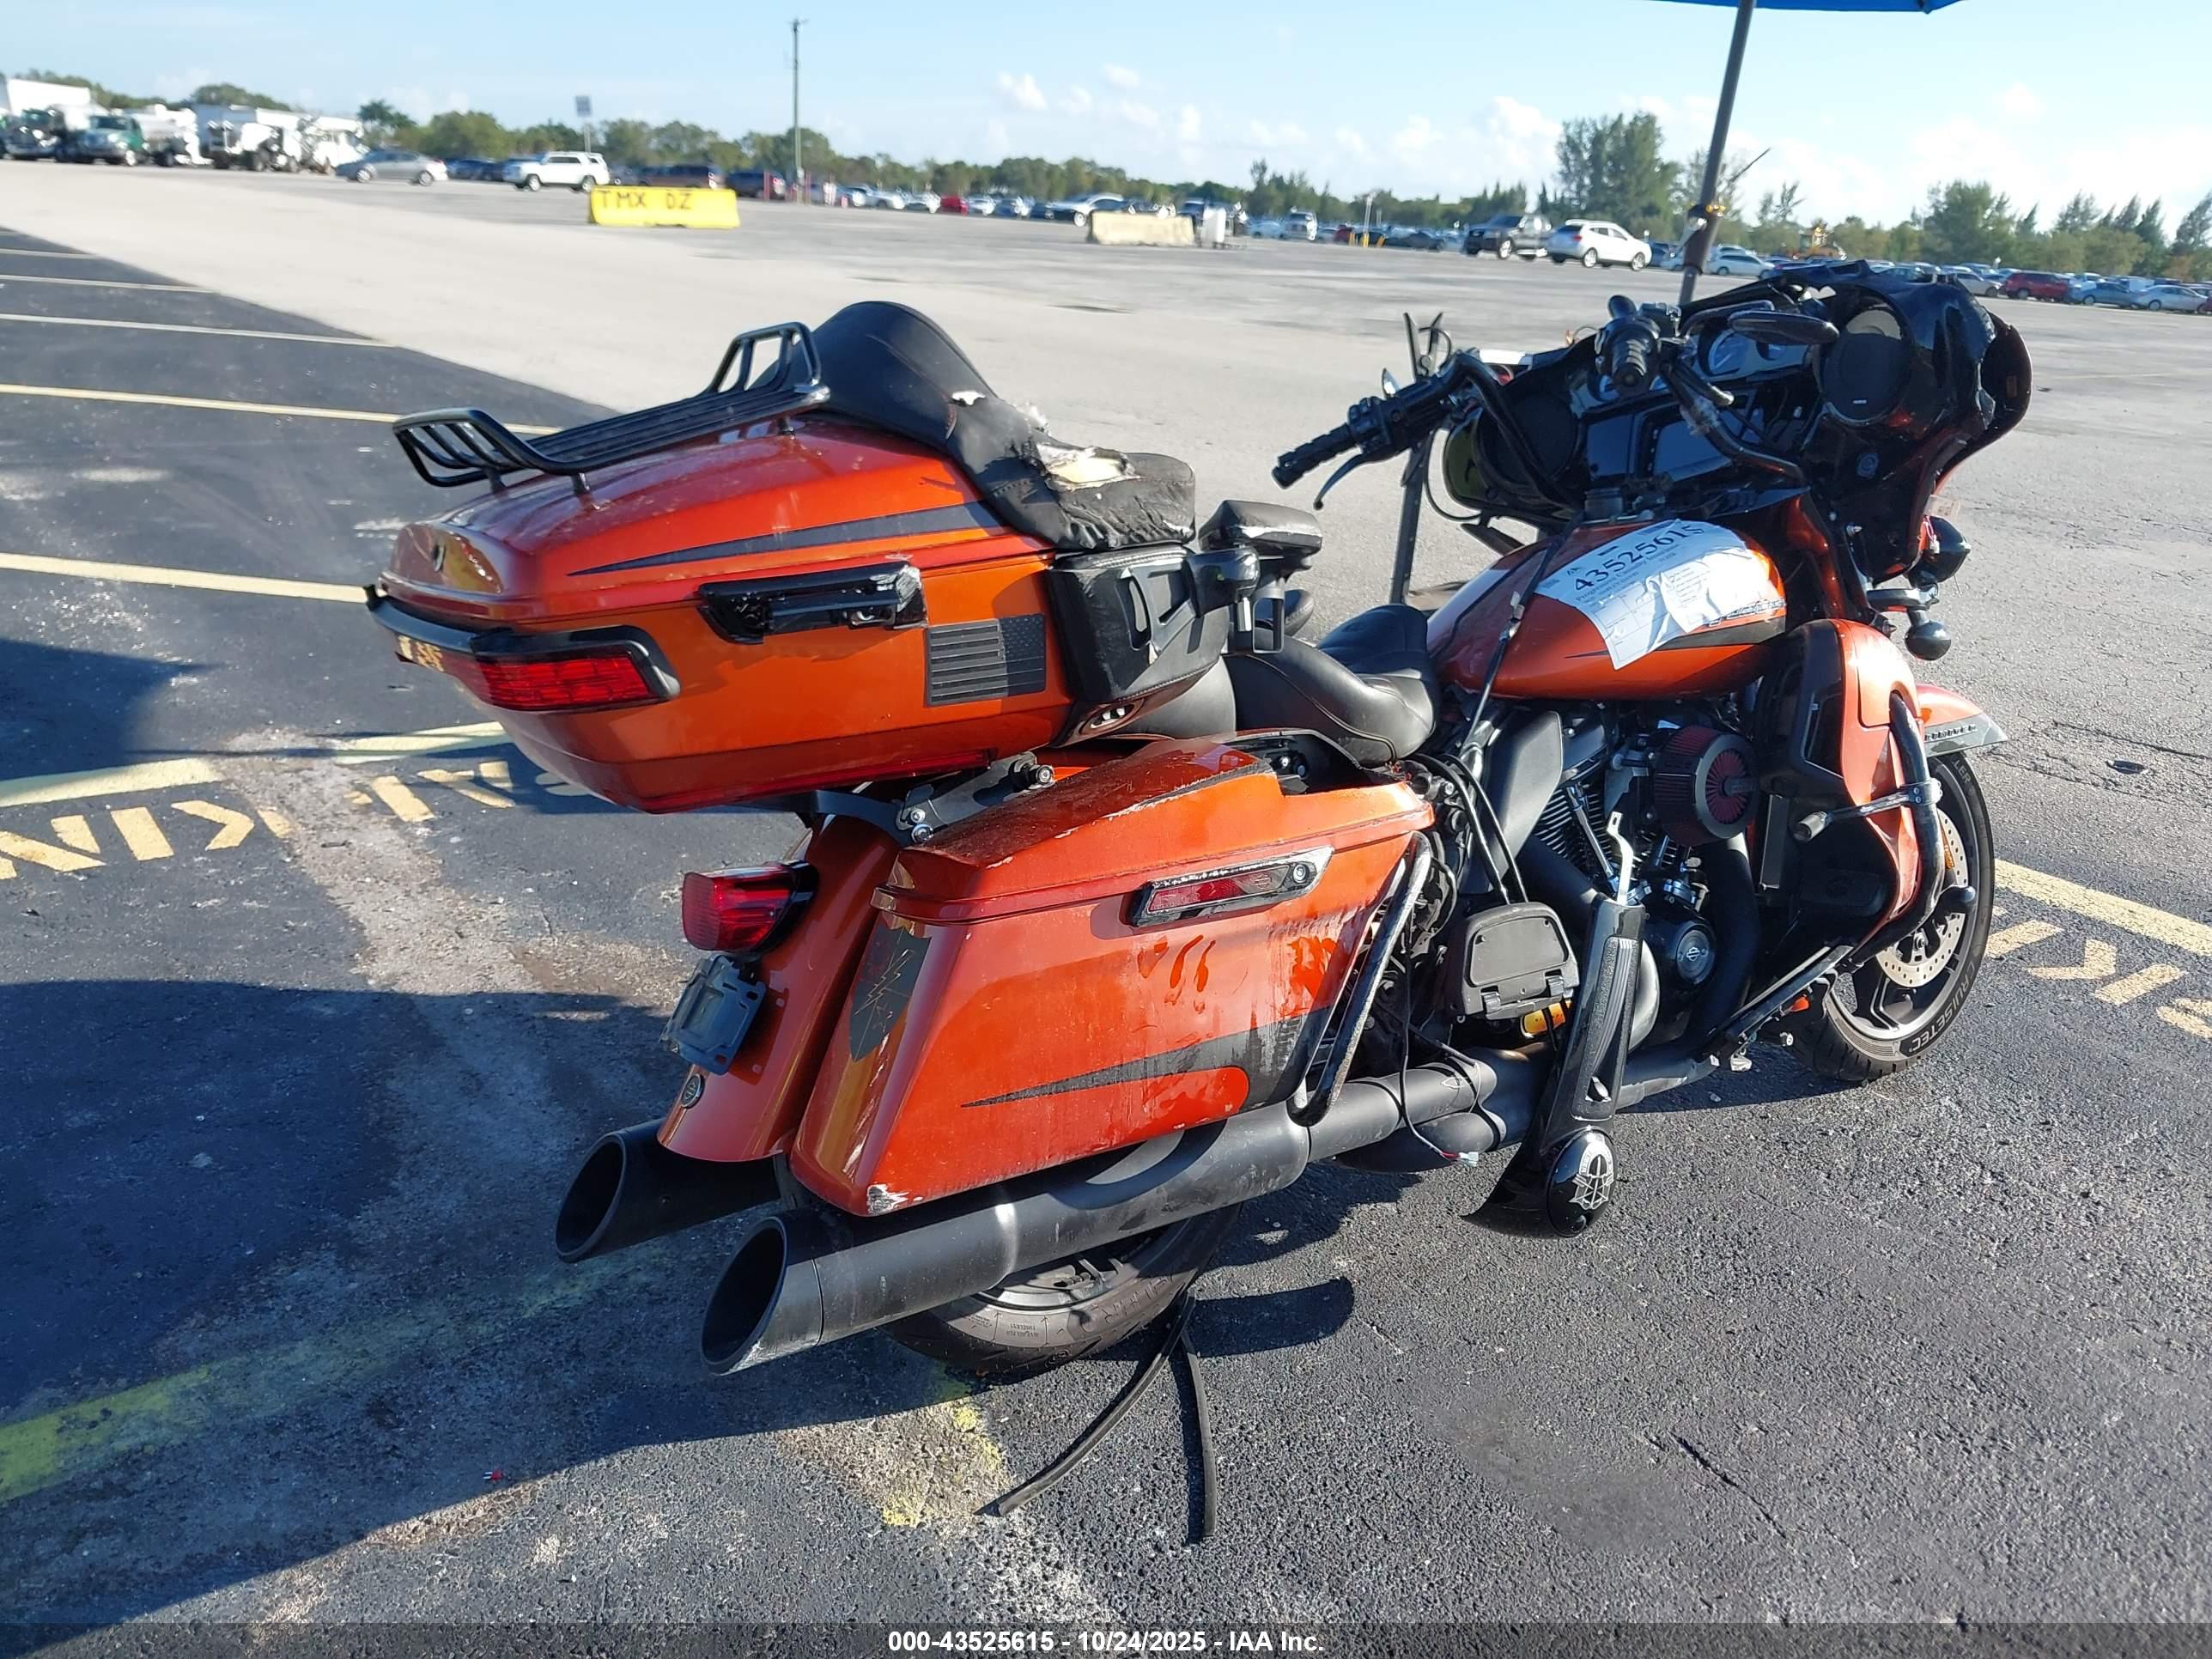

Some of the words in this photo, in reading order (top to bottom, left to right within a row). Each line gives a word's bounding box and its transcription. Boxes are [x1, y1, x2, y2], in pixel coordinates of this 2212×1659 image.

[597, 190, 647, 209] TMX
[1574, 525, 1705, 592] 43525615
[1908, 960, 1978, 1053] CRUISETEC
